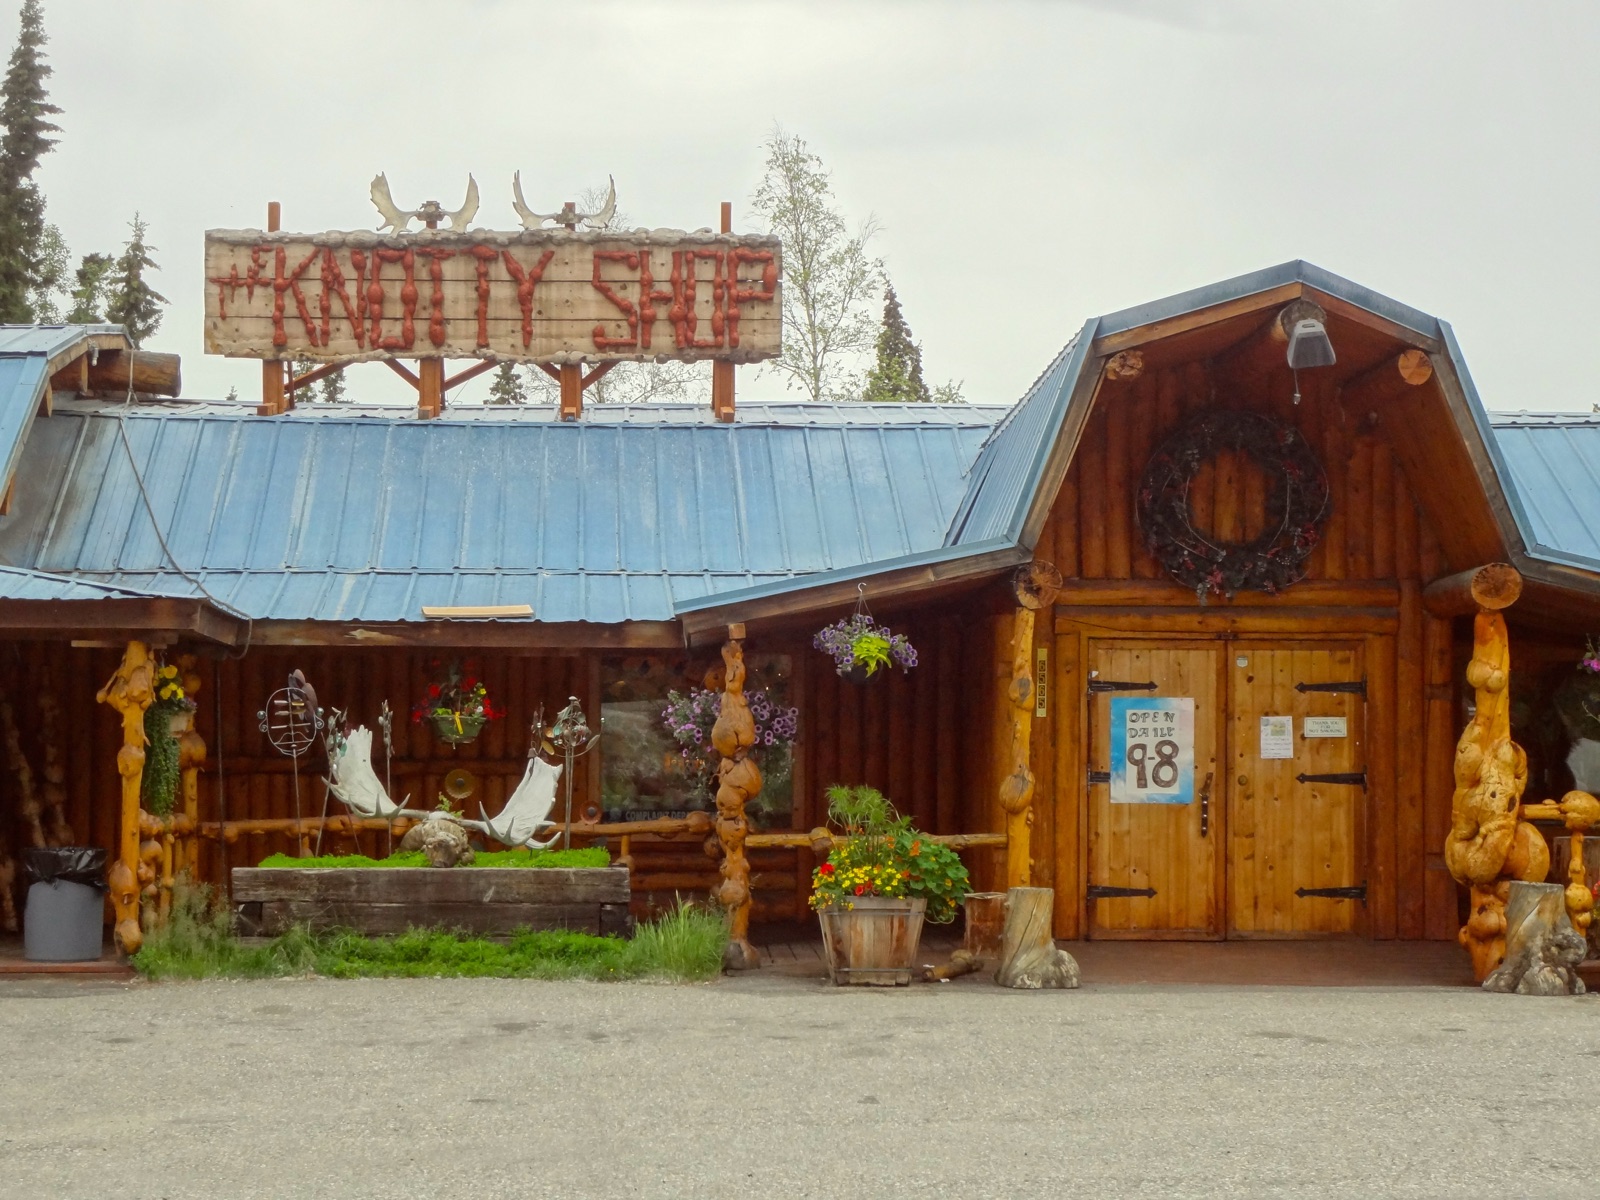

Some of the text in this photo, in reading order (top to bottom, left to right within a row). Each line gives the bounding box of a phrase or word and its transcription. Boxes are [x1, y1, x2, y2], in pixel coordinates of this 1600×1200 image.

[209, 245, 776, 349] THE KNOTTY SHOP
[1128, 711, 1175, 723] OPEN
[1127, 727, 1175, 738] DAILY
[1127, 740, 1180, 788] 9-8
